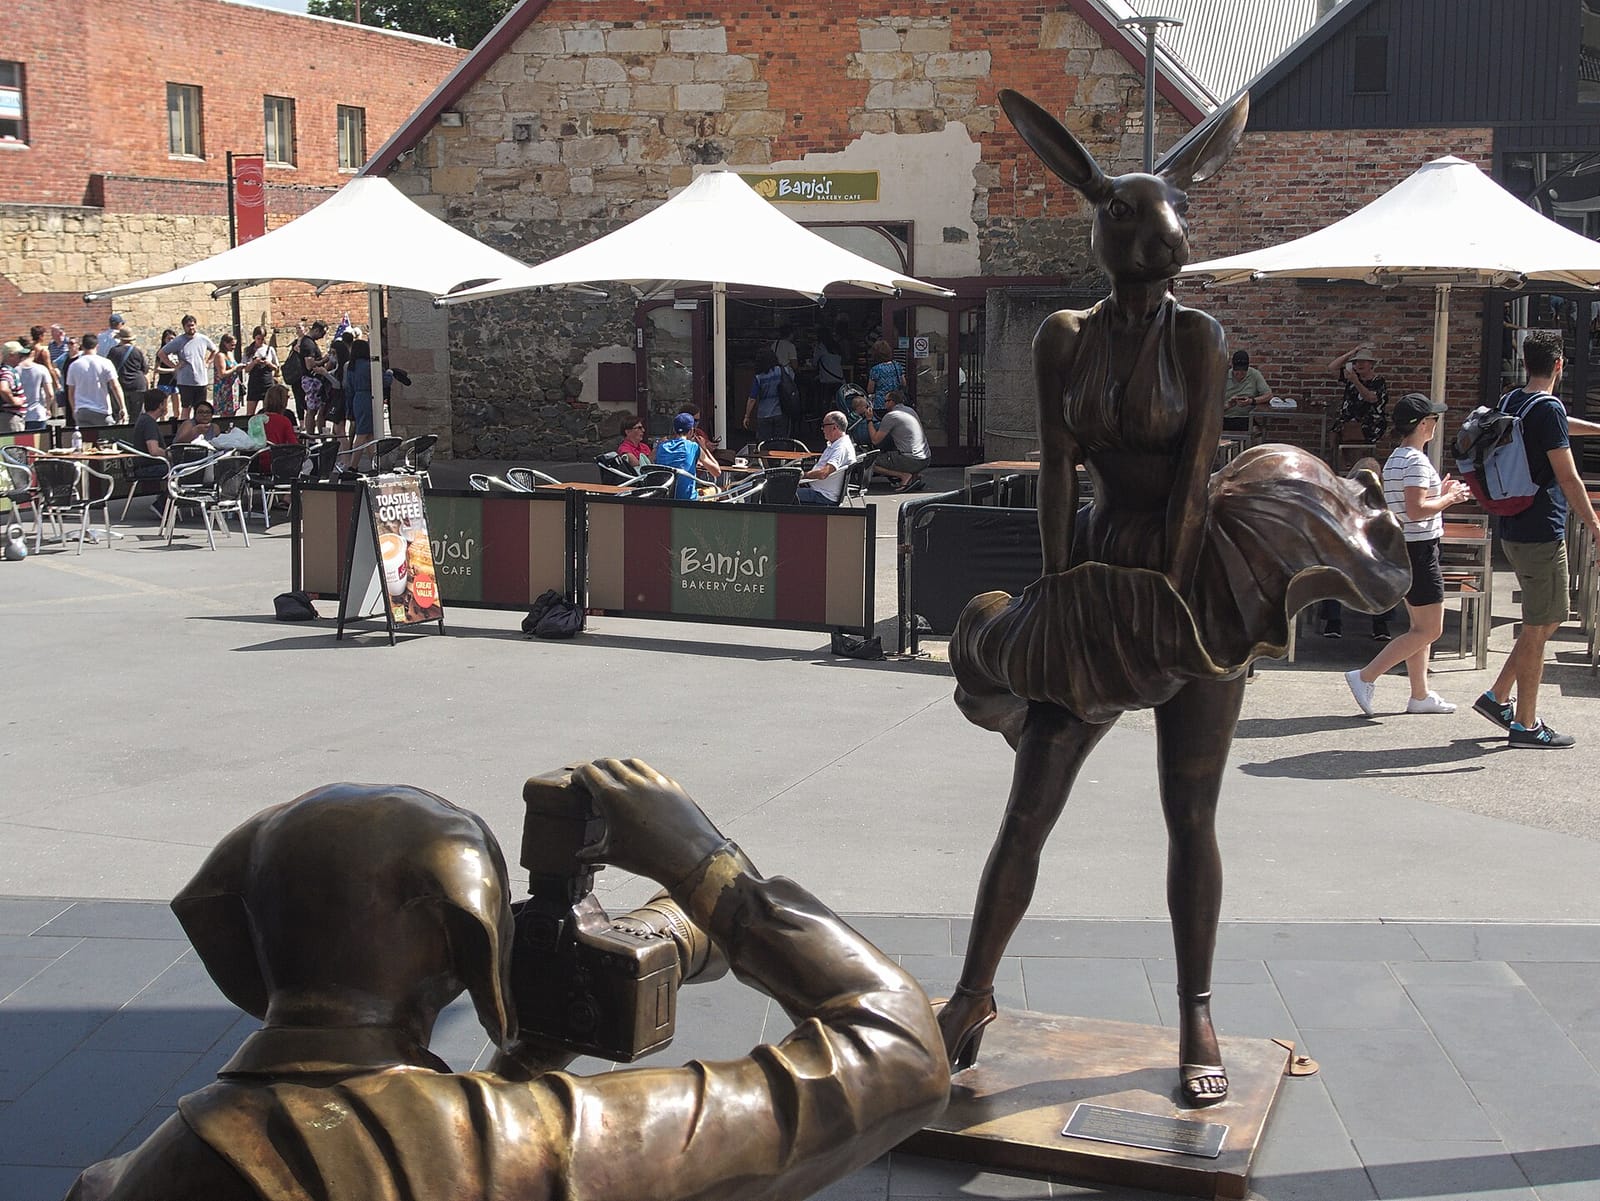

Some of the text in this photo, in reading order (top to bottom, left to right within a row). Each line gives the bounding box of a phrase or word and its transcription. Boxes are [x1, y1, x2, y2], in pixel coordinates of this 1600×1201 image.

[779, 176, 833, 199] Banjo's
[376, 491, 419, 507] TOASTIE &
[380, 503, 421, 522] COFFEE
[442, 565, 472, 576] CAFE
[681, 547, 768, 582] Banjo's
[416, 589, 433, 598] VALUE
[682, 580, 765, 594] BAKERY CAFE
